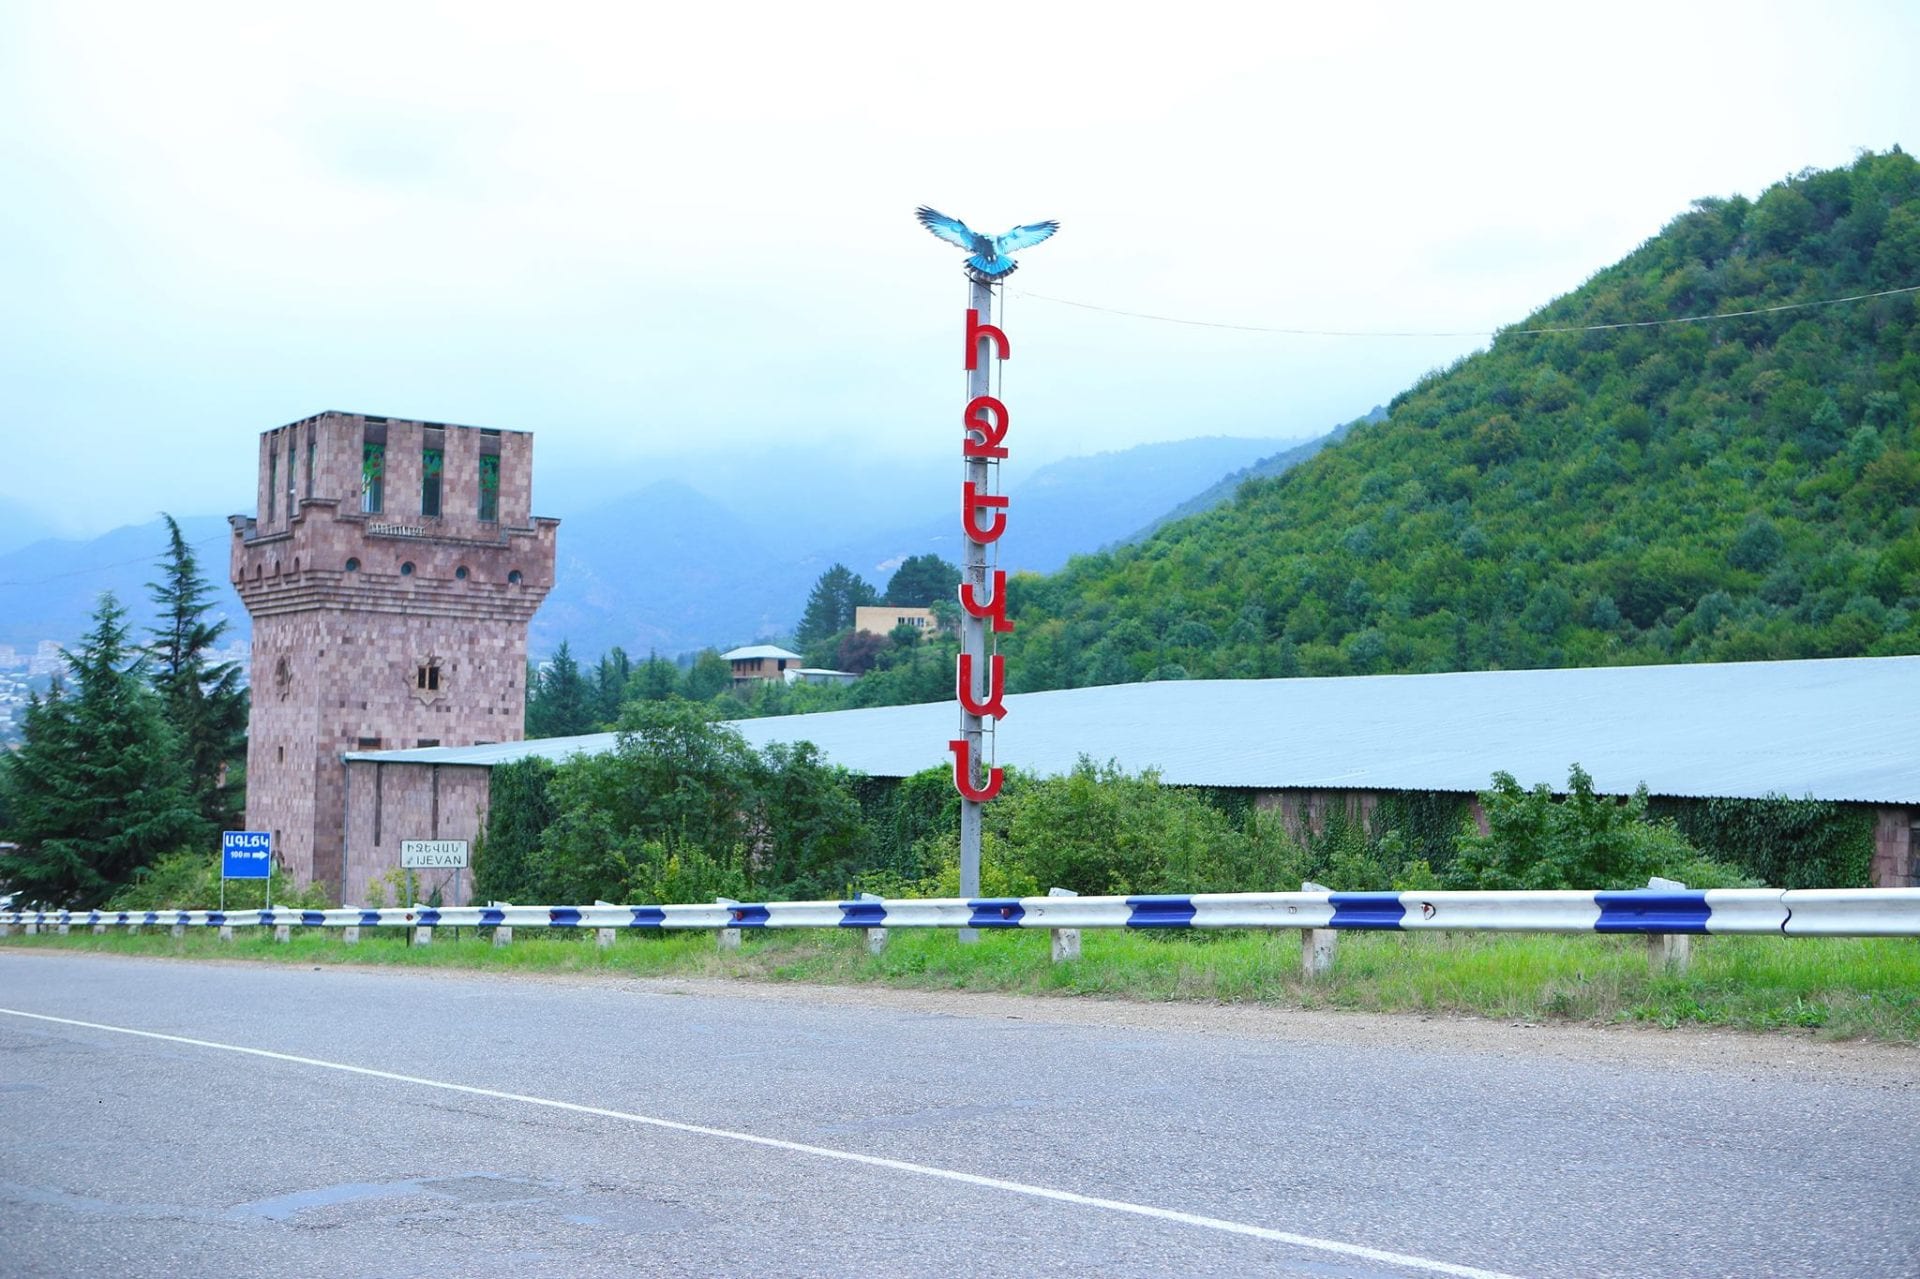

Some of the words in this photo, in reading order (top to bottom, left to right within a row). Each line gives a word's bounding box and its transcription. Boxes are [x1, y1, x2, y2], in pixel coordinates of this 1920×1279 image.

[948, 308, 1015, 803] ԻՋԵՎԱՆ
[407, 843, 459, 853] ԻՋԵՎԱՆ
[416, 855, 461, 865] IJEVAN
